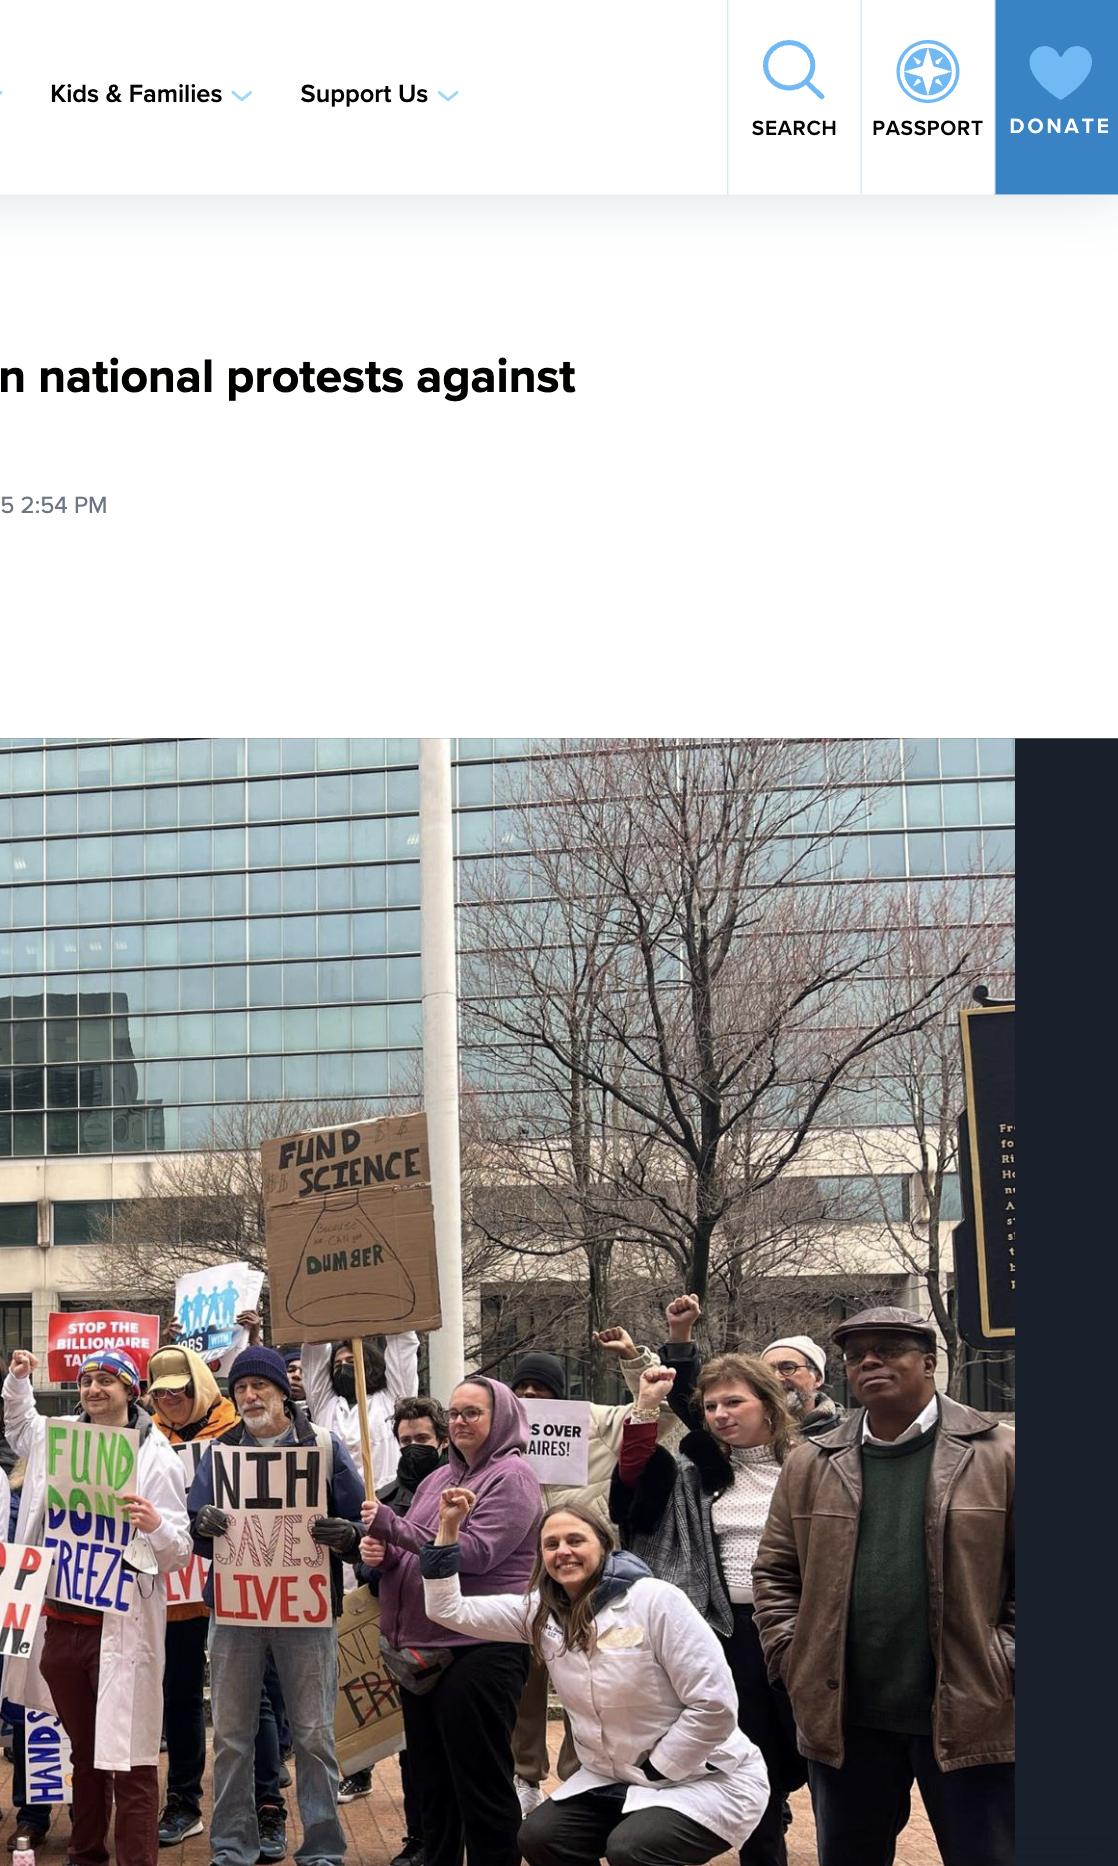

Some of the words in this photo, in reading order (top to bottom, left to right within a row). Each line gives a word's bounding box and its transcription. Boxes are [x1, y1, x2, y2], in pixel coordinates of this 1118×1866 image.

[52, 84, 99, 103] Kids
[106, 84, 123, 103] &
[130, 84, 222, 103] Families
[301, 84, 392, 107] Support
[399, 84, 428, 103] Us
[752, 120, 836, 136] SEARCH
[873, 120, 983, 136] PASSPORT
[1010, 118, 1109, 134] DONATE
[41, 357, 212, 393] national
[229, 362, 403, 402] protests
[417, 357, 576, 402] against
[21, 496, 67, 514] 2:54
[75, 496, 106, 514] PM
[999, 1124, 1016, 1133] Fr
[279, 1129, 360, 1170] FUND
[298, 1148, 421, 1197] SCIENCE
[306, 1244, 384, 1275] DUMBER
[68, 1322, 107, 1335] STOP
[110, 1321, 139, 1334] THE
[56, 1336, 150, 1350] BILLIONAIRE
[178, 1336, 203, 1351] OBS
[63, 1353, 90, 1367] TA
[543, 1424, 582, 1438] OVER
[525, 1440, 570, 1457] AIRES!
[48, 1426, 135, 1491] FUND
[214, 1451, 320, 1510] NIH
[215, 1514, 325, 1568] SAVES
[215, 1572, 328, 1624] LIVES
[26, 1711, 65, 1803] HANDS
